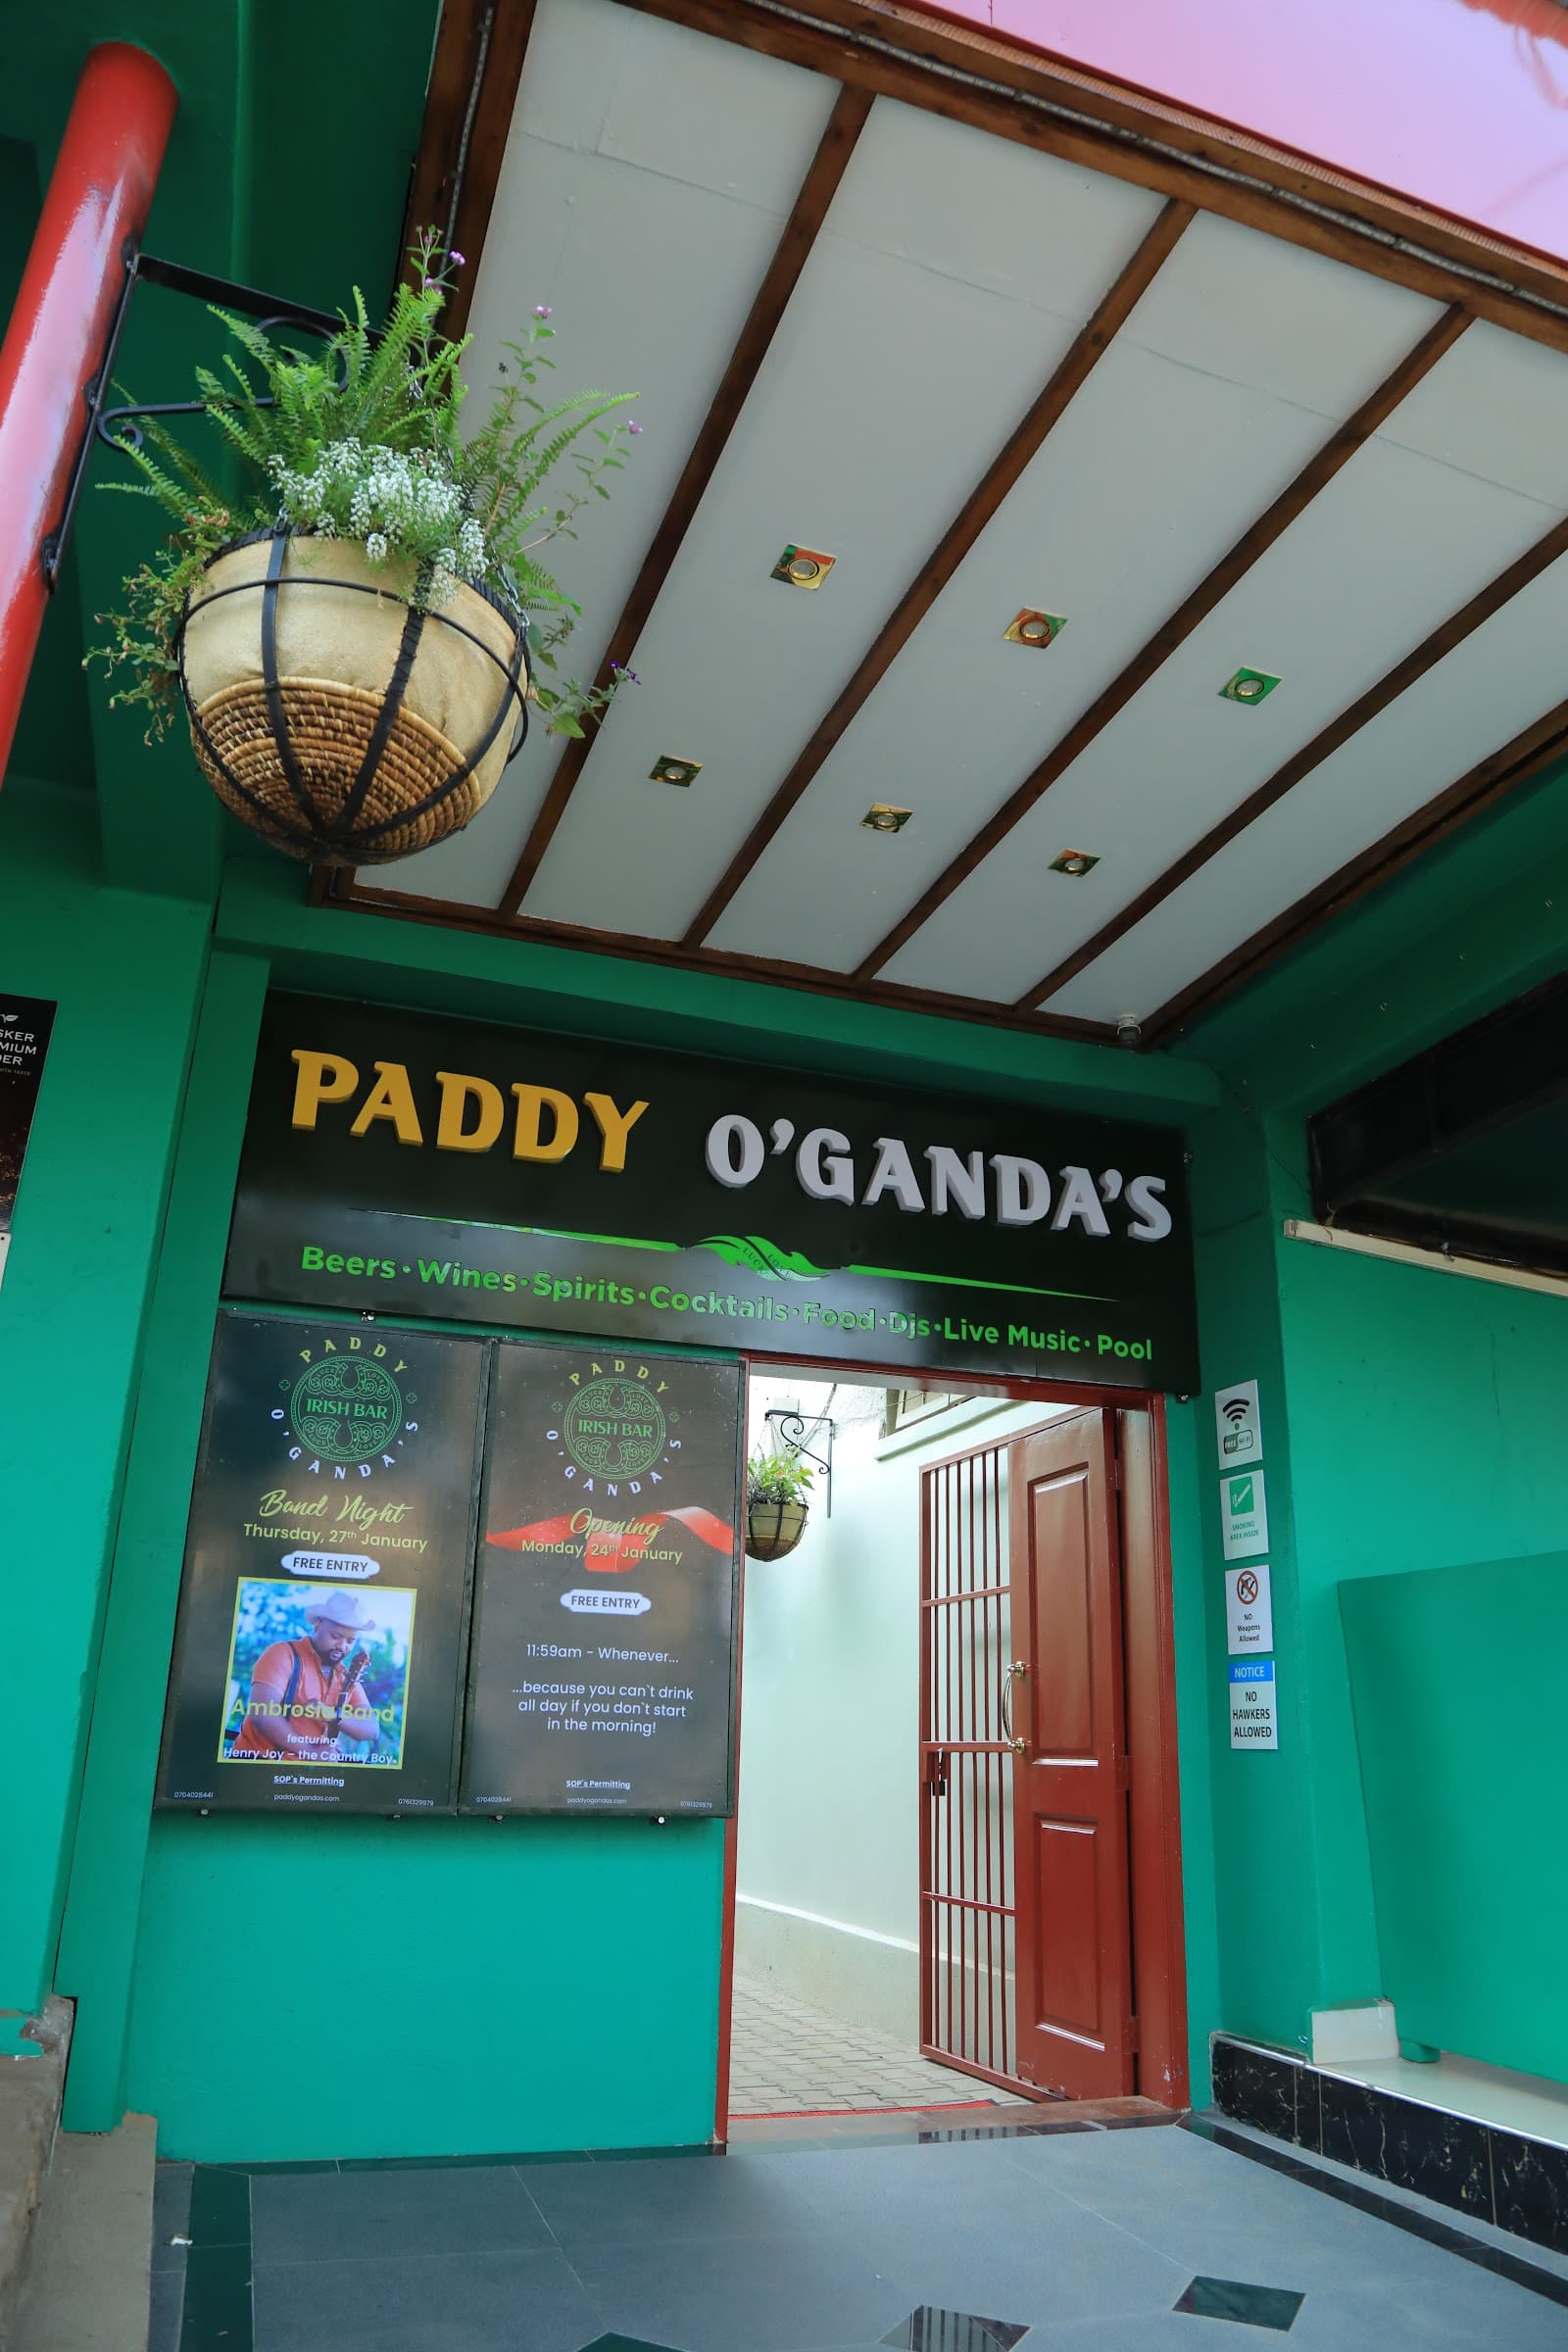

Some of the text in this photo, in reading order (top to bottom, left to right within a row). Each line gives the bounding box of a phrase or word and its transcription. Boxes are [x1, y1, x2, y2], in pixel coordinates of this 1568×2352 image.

[290, 1049, 1173, 1241] PADDY O'GANDA'S
[301, 1246, 1152, 1360] Beers Wines Spirits Cocktails Food Djs Live Music Pool
[299, 1337, 408, 1374] PADDY
[569, 1359, 669, 1394] PADDY
[306, 1397, 387, 1419] IRISH BAR
[578, 1419, 653, 1438] IRISH BAR
[259, 1489, 415, 1532] Band Night
[568, 1507, 664, 1545] Opening
[1232, 1521, 1254, 1532] SMOKING
[243, 1524, 325, 1545] Thursday,
[361, 1534, 428, 1553] January
[1230, 1532, 1243, 1542] AREA
[521, 1539, 587, 1557] Monday,
[621, 1545, 683, 1564] January
[293, 1557, 368, 1573] FREE ENTRY
[571, 1595, 640, 1609] FREE ENTRY
[1237, 1624, 1260, 1634] Weapons
[526, 1643, 582, 1658] 11:59am
[598, 1647, 679, 1663] Whenever...
[1234, 1665, 1265, 1679] NOTICE
[512, 1681, 585, 1694] ...because
[589, 1685, 616, 1699] you
[659, 1686, 694, 1700] drink
[1245, 1690, 1257, 1702] NO
[231, 1699, 394, 1722] Ambrosia Band
[518, 1699, 535, 1712] all
[539, 1699, 566, 1716] day
[571, 1699, 580, 1713] if
[583, 1703, 610, 1719] you
[653, 1704, 686, 1717] start
[1232, 1708, 1271, 1720] HAWKERS
[547, 1717, 656, 1737] in the morning!
[1234, 1726, 1272, 1738] ALLOWED
[287, 1734, 337, 1746] featuring
[223, 1748, 261, 1760] Henry
[263, 1748, 283, 1761] Joy
[298, 1750, 318, 1761] the
[320, 1750, 368, 1764] Country
[299, 1777, 344, 1787] Permitting
[589, 1780, 631, 1789] Permitting
